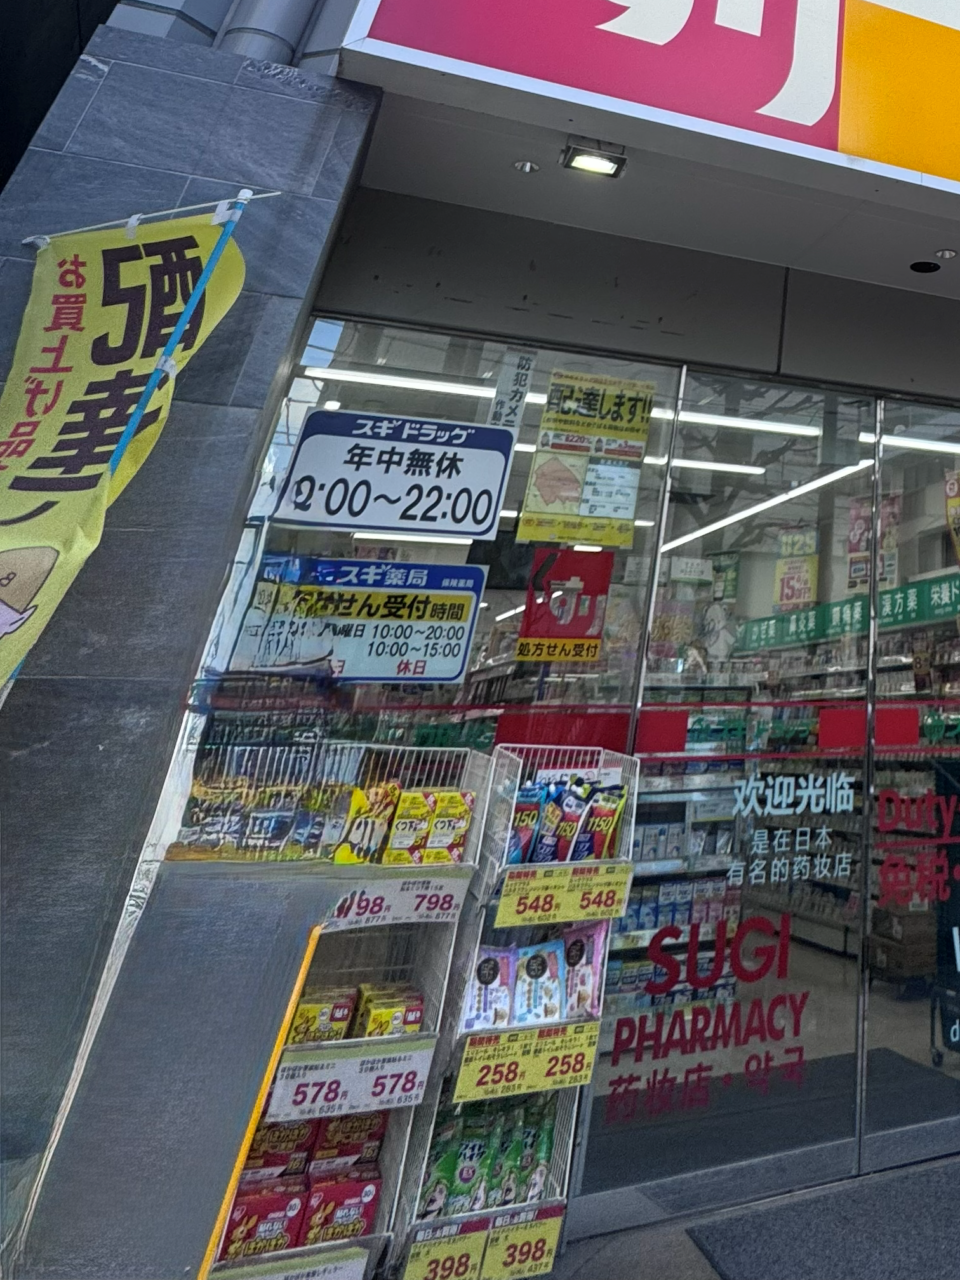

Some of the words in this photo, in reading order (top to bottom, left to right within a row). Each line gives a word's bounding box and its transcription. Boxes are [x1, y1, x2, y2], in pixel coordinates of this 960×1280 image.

[343, 445, 464, 480] 年中無休
[396, 659, 428, 676] 休日
[516, 642, 599, 659] 処方せん受付
[731, 773, 855, 818] 欢迎光临
[749, 827, 833, 855] 是在日本
[725, 852, 852, 885] 有名的药妆店
[645, 913, 791, 996] SUGI
[610, 991, 809, 1067] PHARMACY
